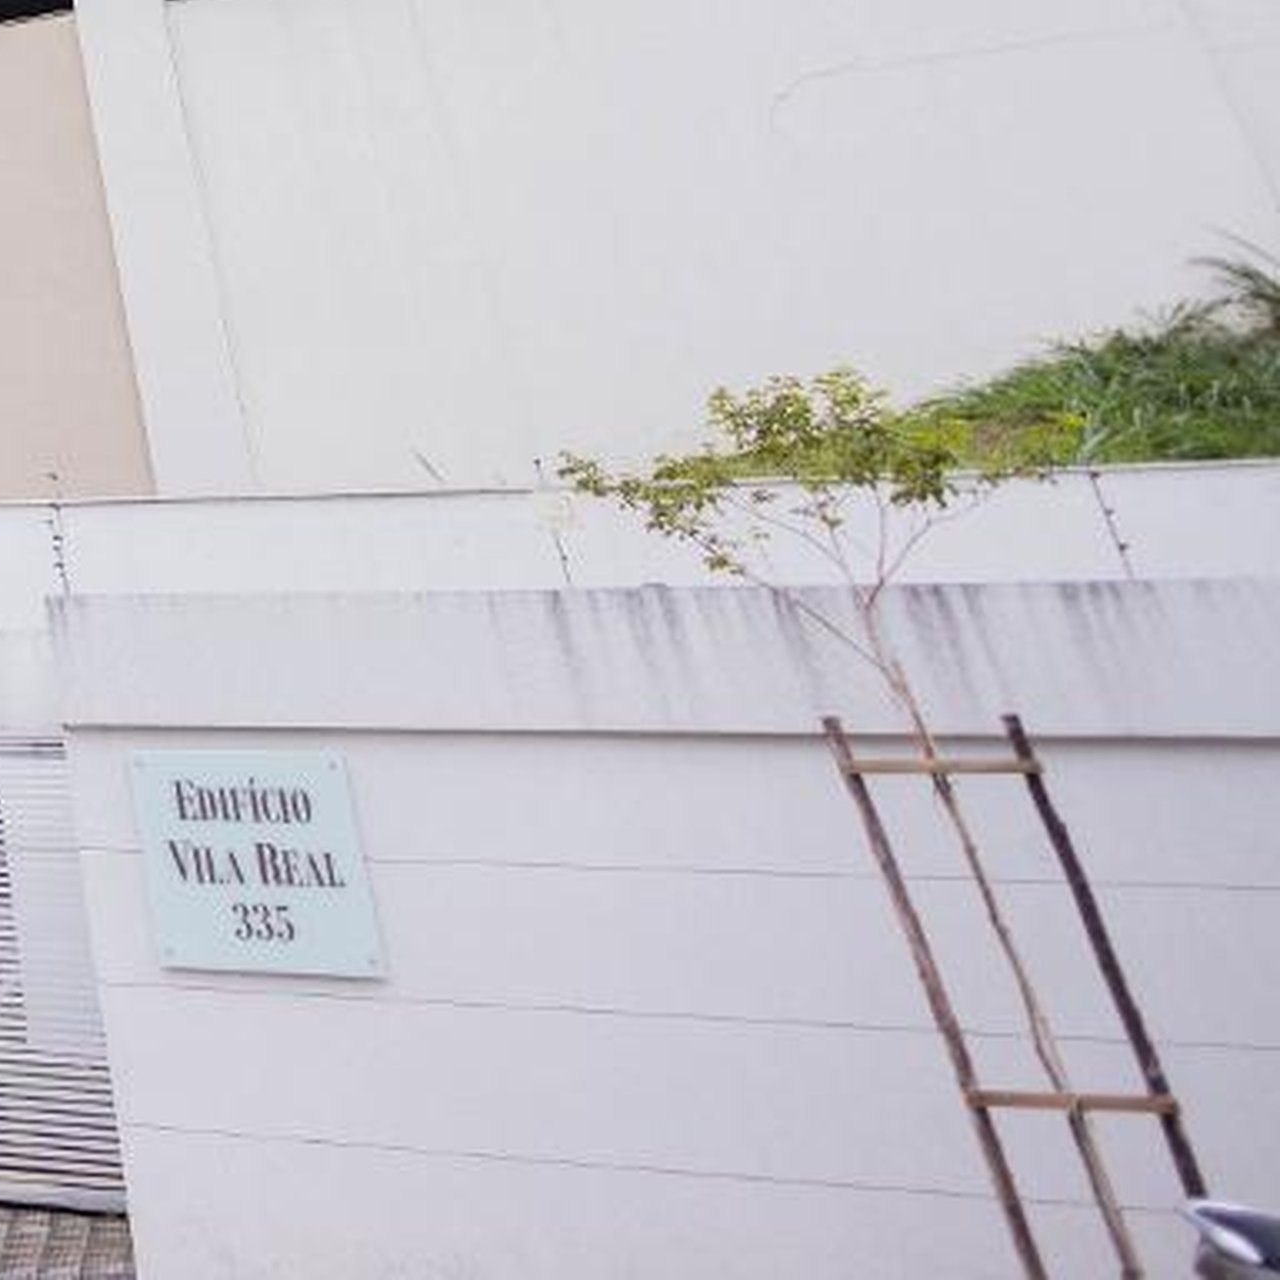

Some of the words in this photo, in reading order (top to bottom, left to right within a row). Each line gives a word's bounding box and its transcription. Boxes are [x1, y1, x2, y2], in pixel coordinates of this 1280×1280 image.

[174, 776, 312, 824] EDIFÍCIO
[168, 839, 245, 885] VILA
[254, 841, 347, 888] REAL
[231, 902, 296, 942] 335
